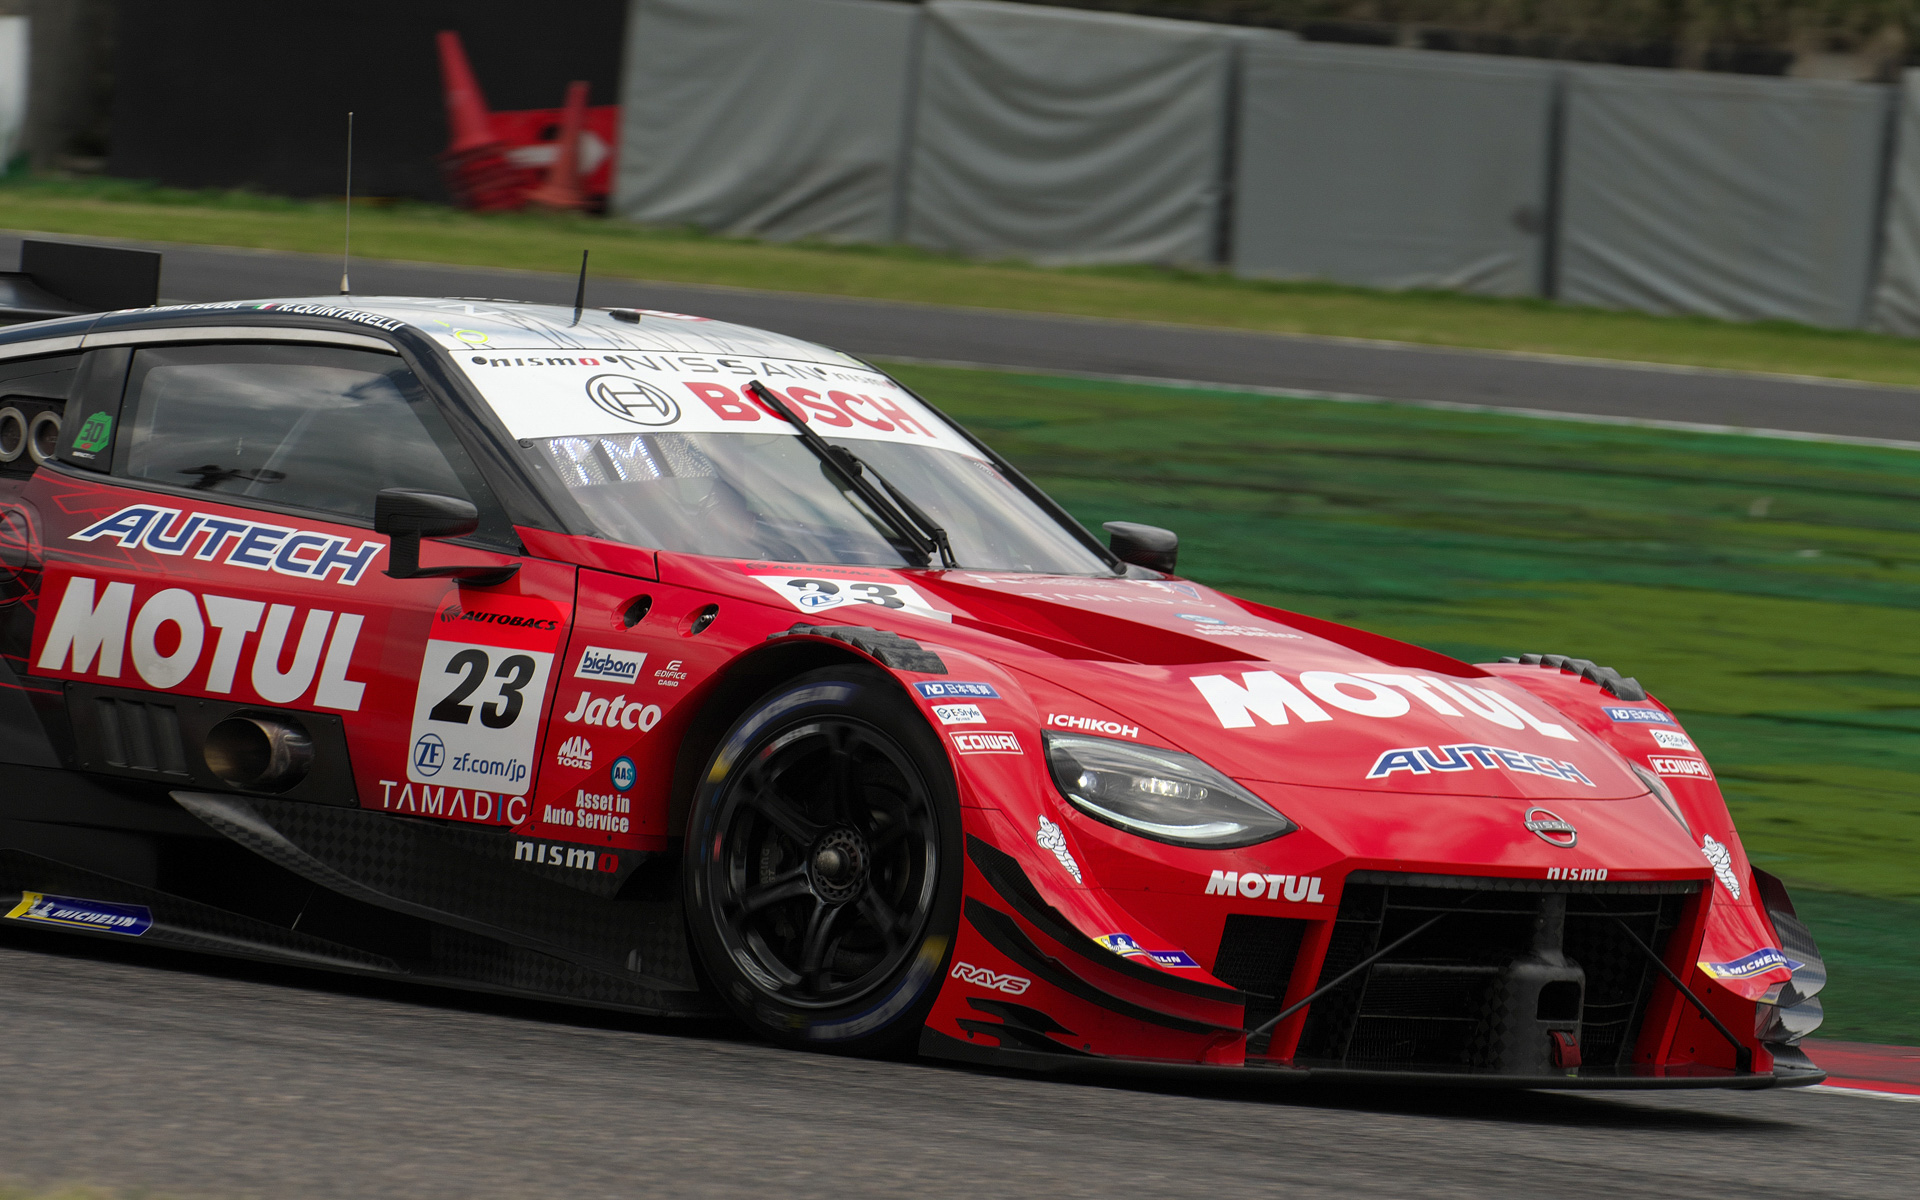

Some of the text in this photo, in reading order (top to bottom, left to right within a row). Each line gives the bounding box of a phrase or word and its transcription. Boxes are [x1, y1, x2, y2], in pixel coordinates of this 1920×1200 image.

[276, 303, 405, 332] R.QUINTARELLI
[489, 357, 600, 367] nismo
[616, 354, 827, 381] NISSAN
[683, 381, 937, 439] BOSCH
[80, 420, 105, 443] 30
[68, 504, 386, 586] AUTECH
[787, 579, 905, 609] 23
[460, 610, 559, 631] AUTOBACS
[36, 576, 367, 711] MOTUL
[582, 650, 638, 675] bigborn
[654, 669, 688, 680] EDIFICE
[428, 648, 536, 729] 23
[657, 679, 679, 688] CASIO
[564, 691, 662, 733] Jatco
[1189, 670, 1579, 742] MOTUL
[1047, 713, 1139, 738] ICHIKOH
[557, 736, 593, 761] MAC
[452, 753, 527, 782] zf.com/jp
[557, 756, 592, 770] TOOLS
[614, 767, 633, 780] AAS
[1365, 743, 1597, 787] AUTECH
[379, 780, 528, 825] TAMADIC
[575, 789, 630, 813] Asset in
[542, 804, 630, 833] Auto Service
[514, 840, 620, 873] nismo
[1204, 870, 1325, 903] MOTUL
[1546, 867, 1608, 881] nismo
[52, 909, 138, 928] MICHELIN
[951, 961, 1031, 995] RAYS
[1729, 953, 1788, 975] MICHELIN
